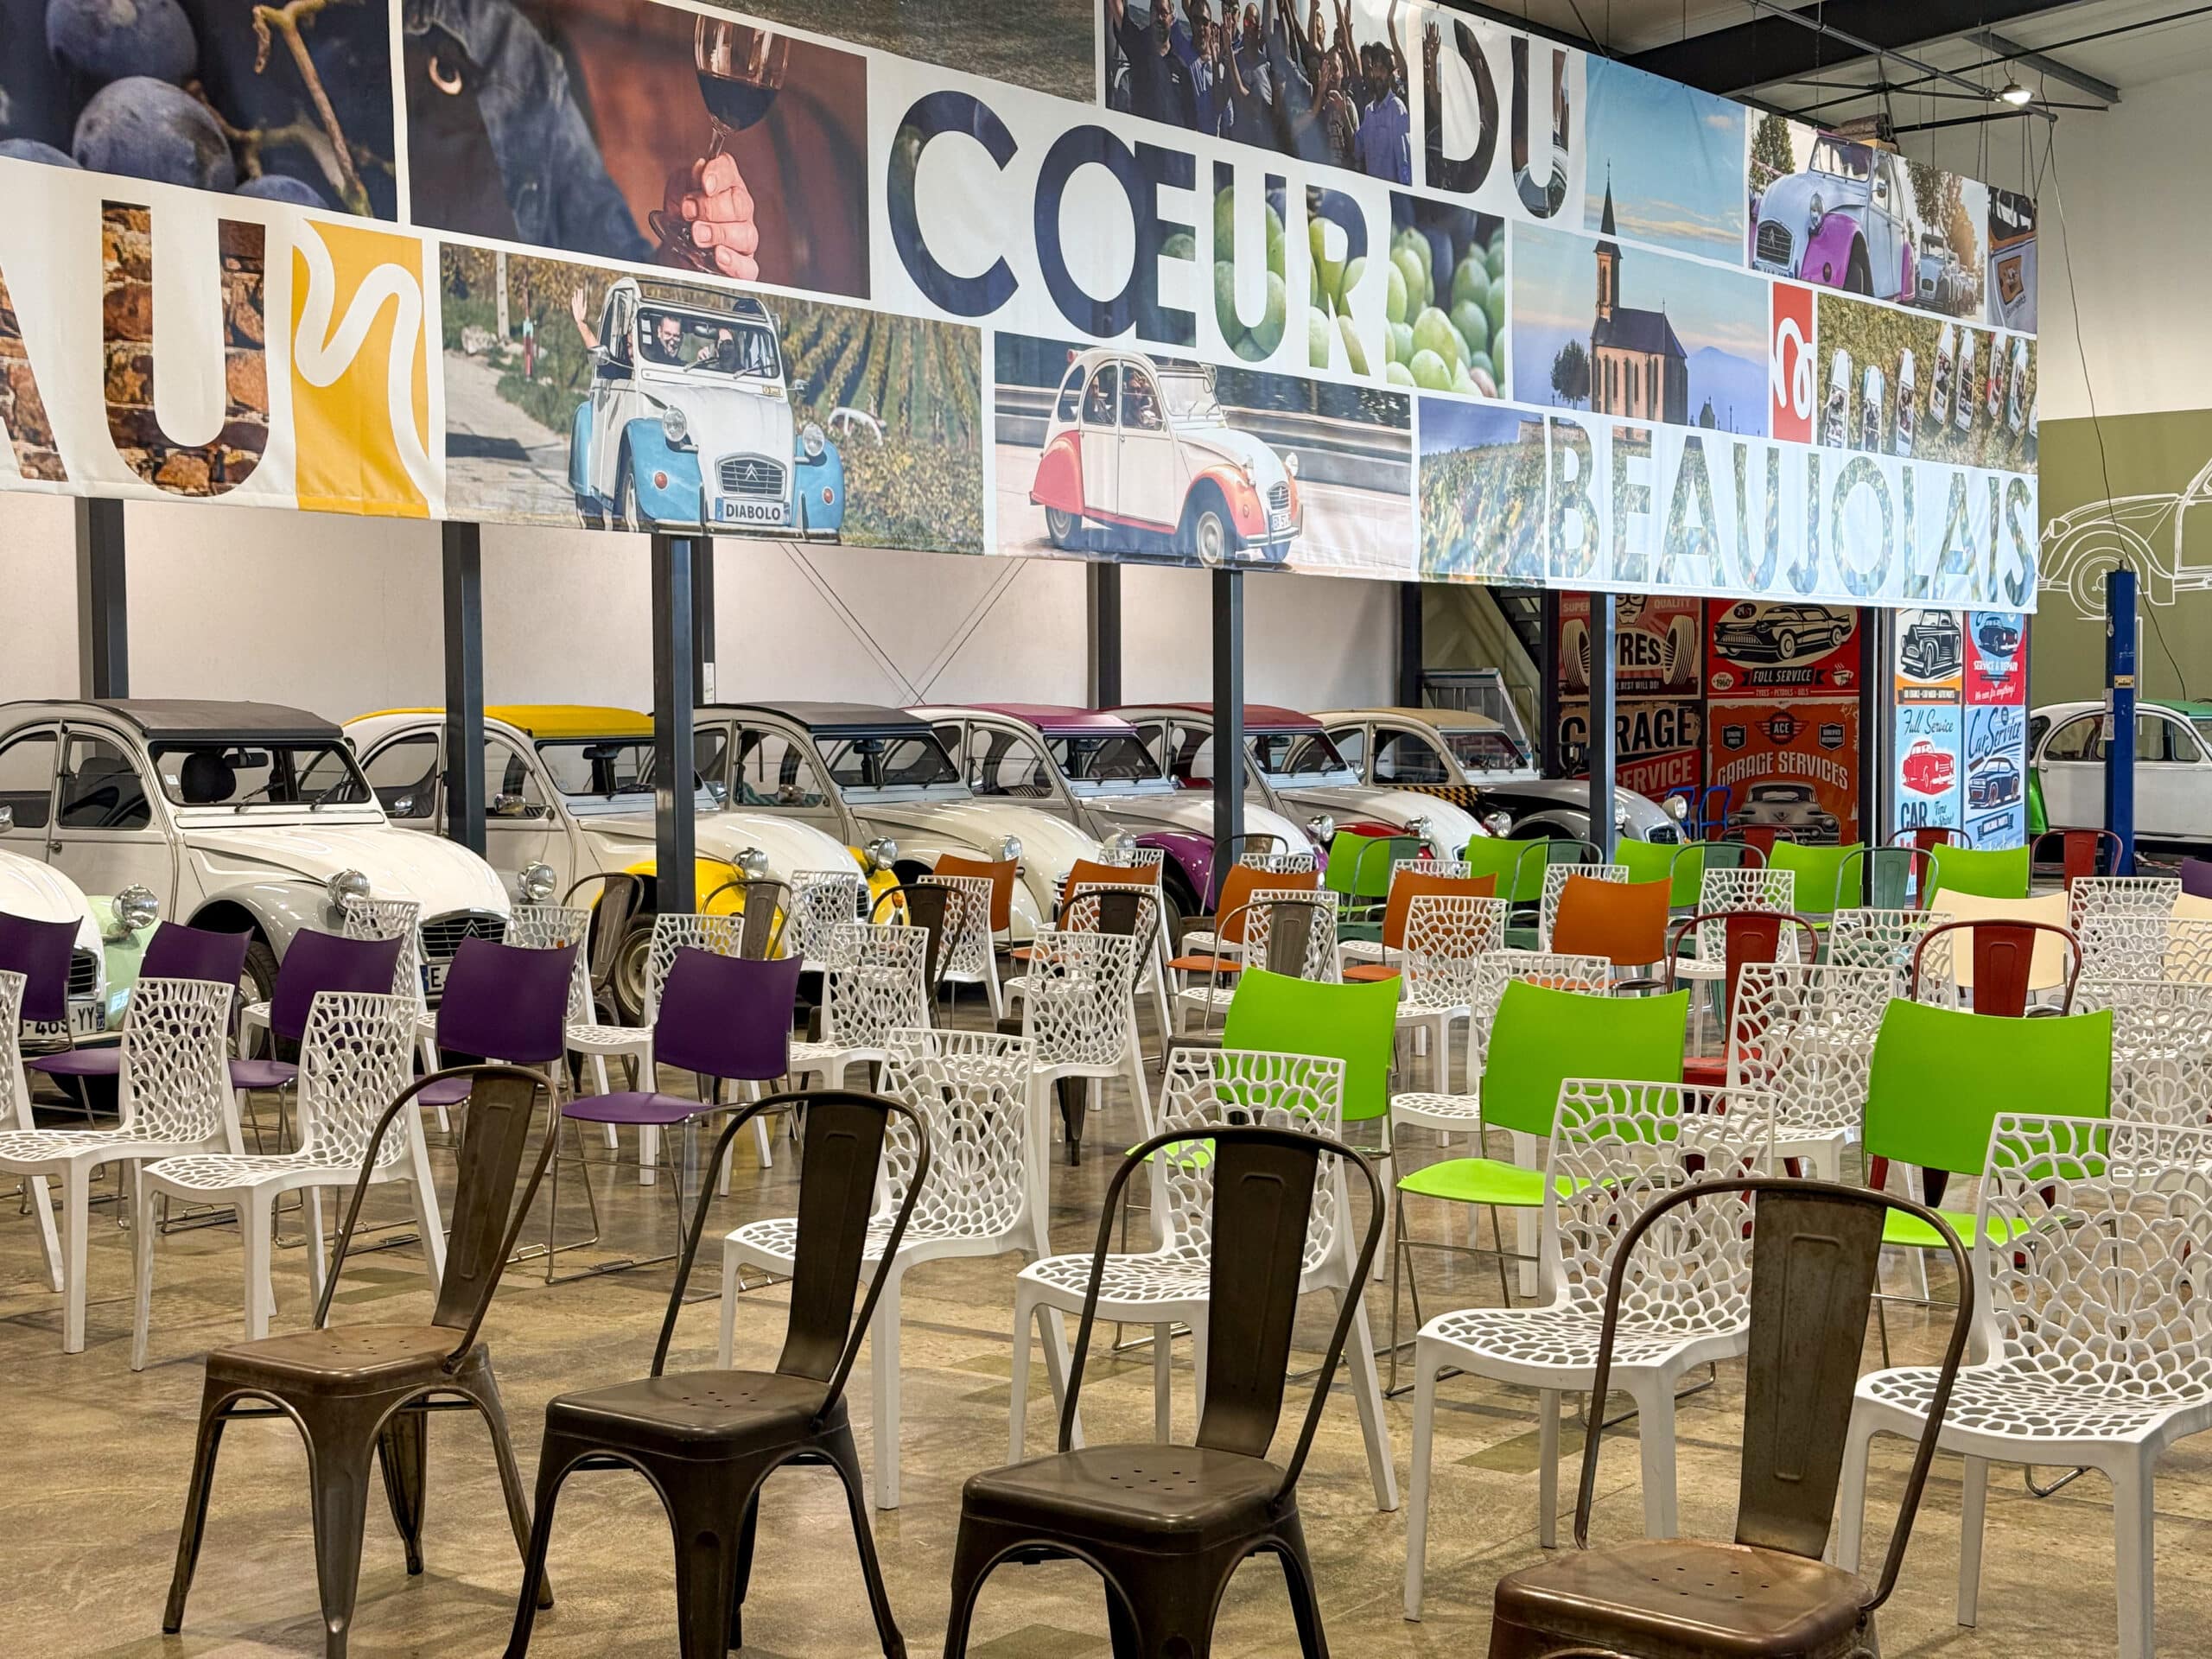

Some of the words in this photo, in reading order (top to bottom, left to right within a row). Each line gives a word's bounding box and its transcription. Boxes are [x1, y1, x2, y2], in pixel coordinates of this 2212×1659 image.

[1422, 10, 1570, 219] DU
[887, 90, 1371, 378] CŒUR
[726, 504, 781, 520] DIABOLO
[1550, 416, 2036, 607] BEAUJOLAIS
[1563, 601, 1590, 613] SUPE
[1655, 599, 1690, 609] QUALITY
[1615, 632, 1662, 666] RES
[1776, 670, 1813, 683] SERVICE
[1773, 722, 1790, 734] ACE
[1904, 709, 1924, 735] Full
[1924, 709, 1954, 734] Service
[1968, 709, 1990, 759] Car
[1984, 707, 2022, 757] Service
[1560, 706, 1694, 772] GRAGE
[1718, 752, 1774, 787] GARAGE
[1778, 750, 1848, 791] SERVICES
[1901, 801, 1929, 830] CAR
